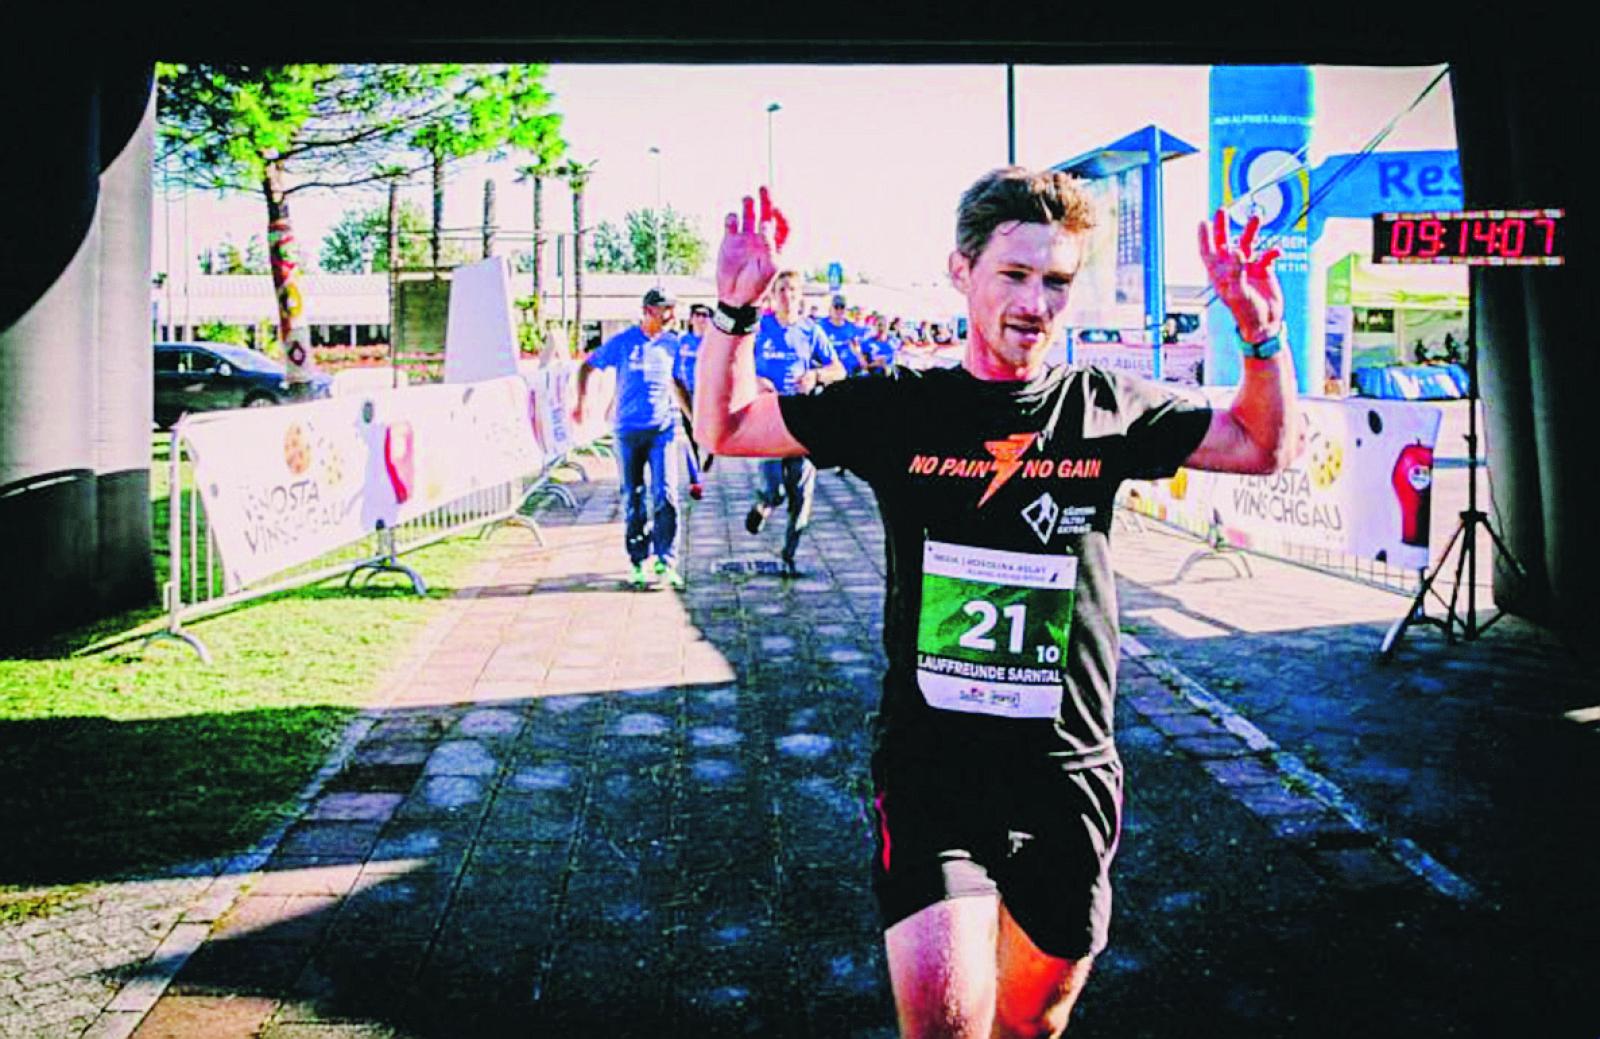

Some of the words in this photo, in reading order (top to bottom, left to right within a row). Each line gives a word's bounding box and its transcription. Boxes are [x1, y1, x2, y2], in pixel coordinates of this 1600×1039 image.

[1390, 218, 1556, 257] 09:14:07
[908, 454, 939, 475] NO
[939, 458, 990, 478] PAIN
[1021, 459, 1055, 478] NO
[1057, 459, 1102, 478] GAIN
[1232, 487, 1343, 531] VINSCHGAU
[959, 600, 1028, 654] 21
[917, 654, 1006, 681] LAUFFREUNDE
[1007, 667, 1063, 683] SARNTAL
[1036, 645, 1061, 664] 10
